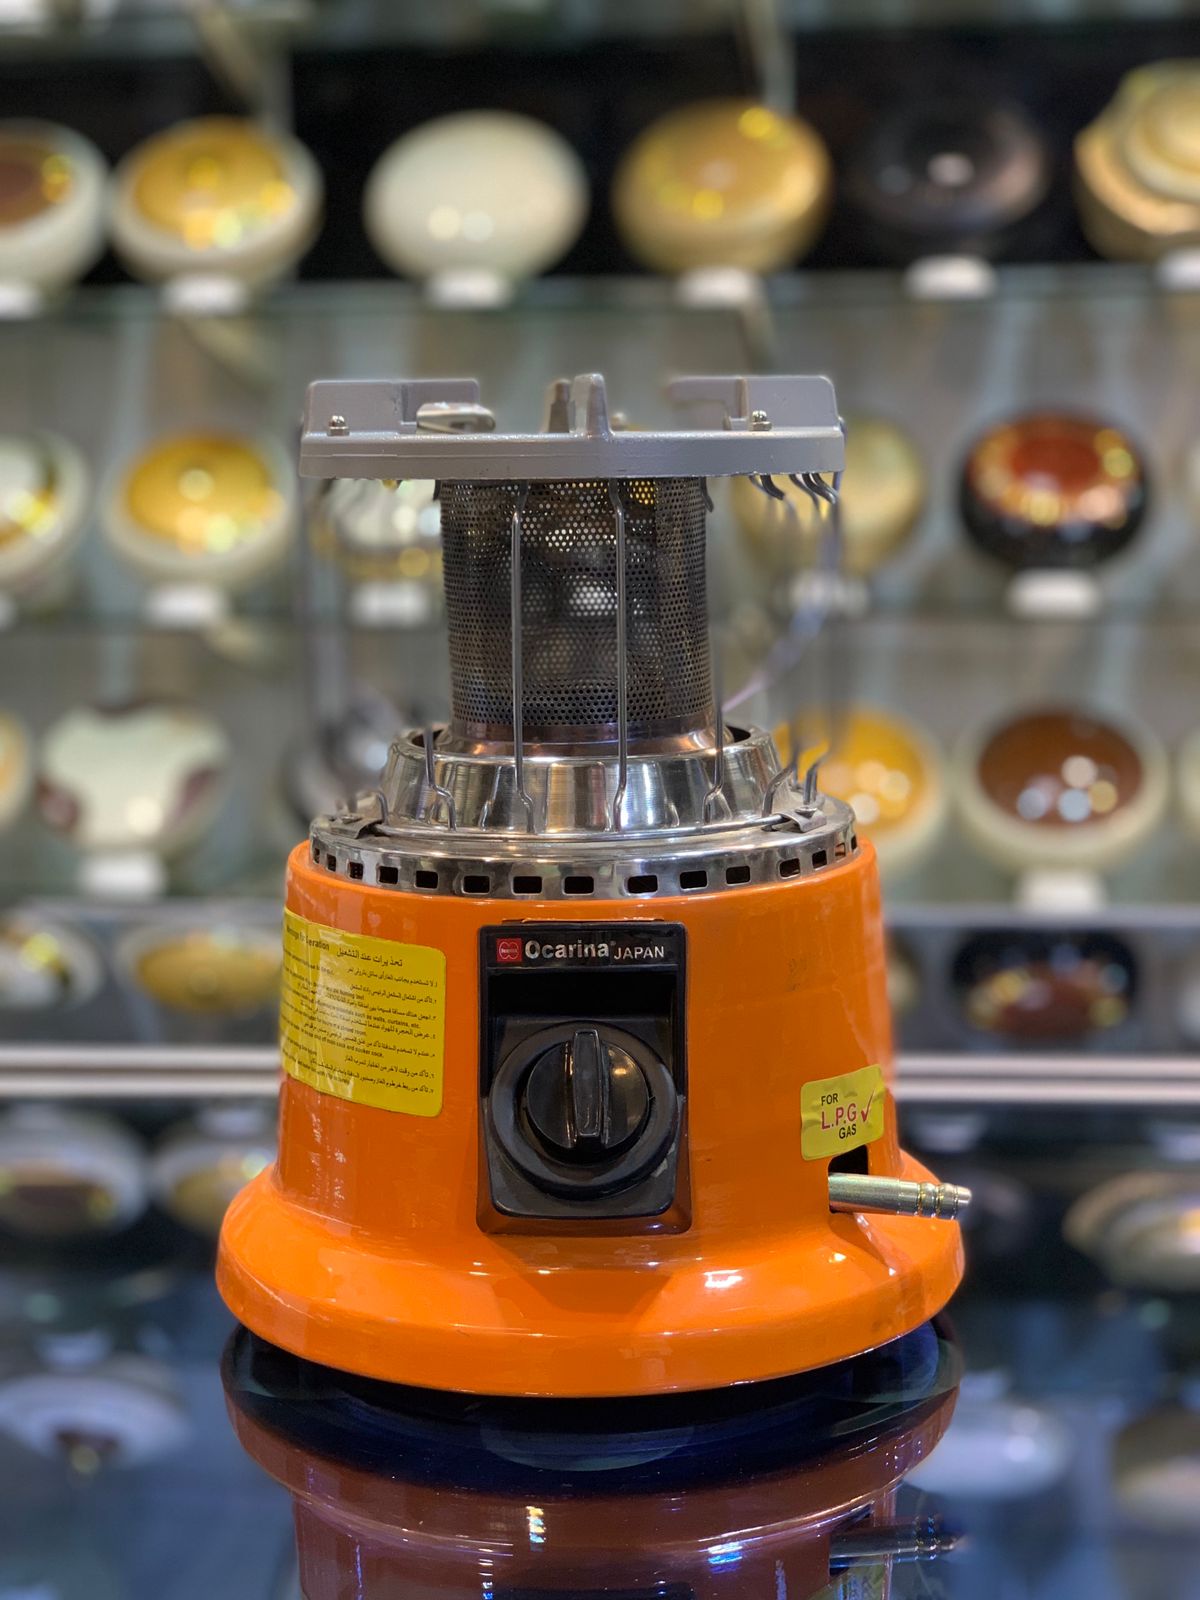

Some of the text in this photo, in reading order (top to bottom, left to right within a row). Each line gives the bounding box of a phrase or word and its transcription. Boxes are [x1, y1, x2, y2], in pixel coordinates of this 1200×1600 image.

[525, 940, 665, 960] Ocarina JAPAN
[821, 1093, 838, 1106] FOR
[821, 1103, 857, 1130] L.P.G
[839, 1124, 857, 1139] GAS
